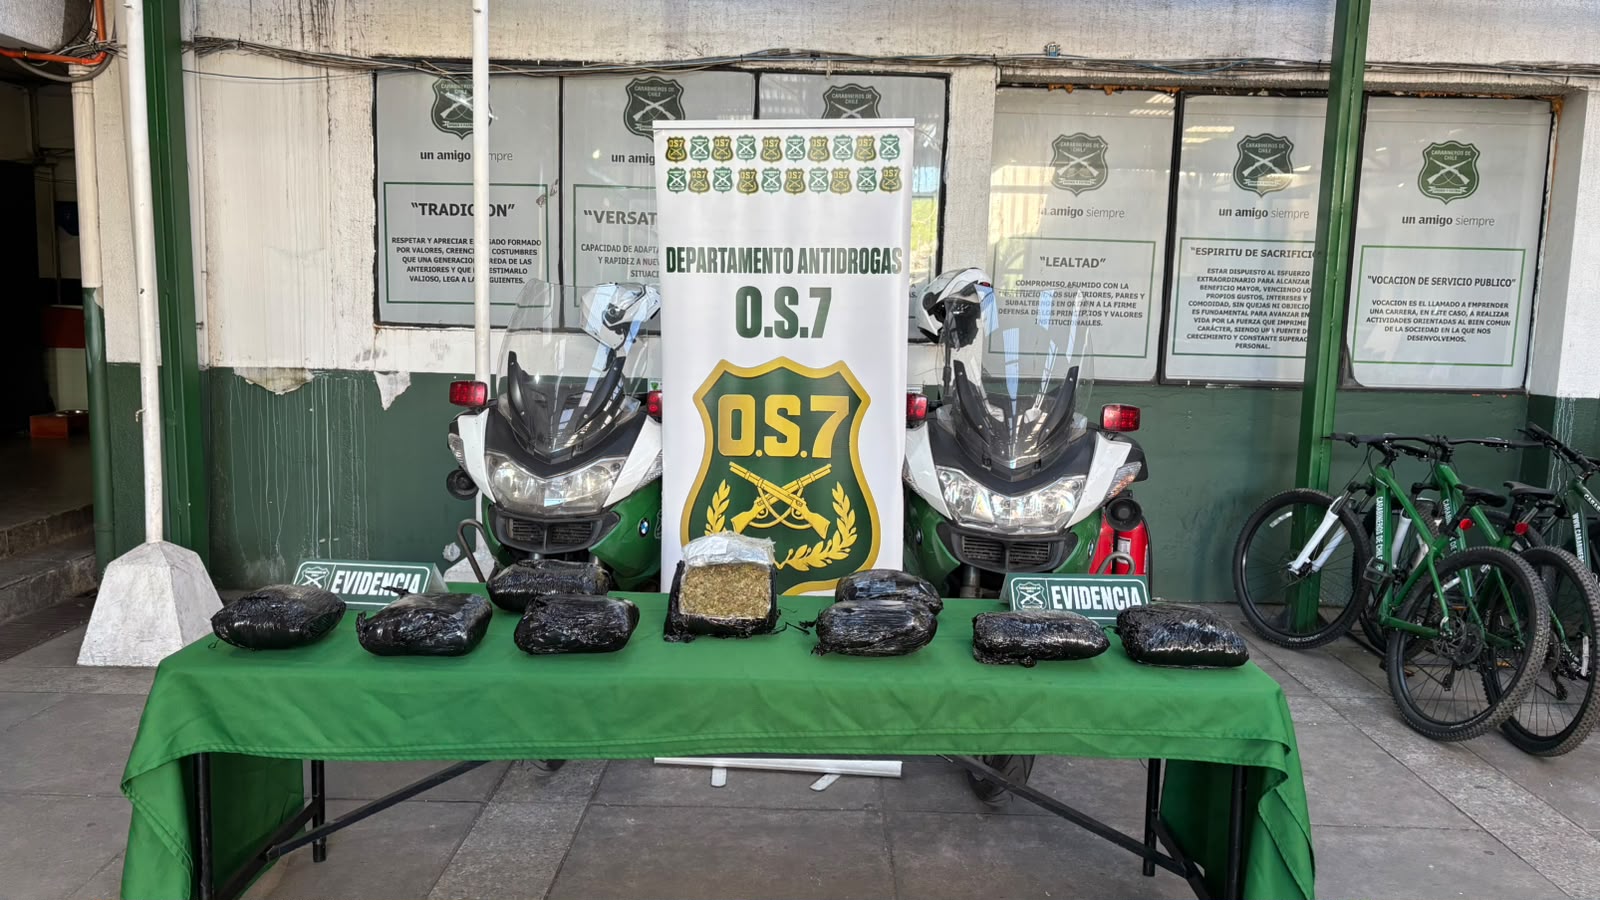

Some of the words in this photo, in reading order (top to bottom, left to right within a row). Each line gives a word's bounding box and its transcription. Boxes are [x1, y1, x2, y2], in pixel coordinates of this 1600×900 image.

[421, 152, 433, 160] un
[437, 150, 471, 162] amigo
[611, 154, 625, 162] un
[629, 153, 655, 165] amig
[411, 202, 515, 217] “TRADICON”
[1050, 207, 1084, 219] amigo
[1086, 208, 1125, 219] siempre
[1219, 208, 1232, 216] un
[1235, 207, 1268, 219] amigo
[1271, 208, 1309, 220] siempre
[584, 210, 657, 225] “VERSAT
[1402, 216, 1415, 224] un
[1418, 215, 1453, 227] amigo
[1456, 215, 1495, 228] siempre
[581, 244, 621, 252] CAPACIDAD
[1245, 249, 1258, 257] DE
[605, 257, 635, 265] RAPIDEZ
[666, 247, 794, 274] DEPARTAMENTO
[797, 247, 902, 274] ANTIDROGAS
[1418, 277, 1429, 285] DE
[1431, 277, 1472, 286] SERVICIO
[735, 286, 832, 339] O.S.7
[718, 394, 849, 458] O.S.7
[1376, 536, 1383, 544] DE
[331, 570, 421, 596] EVIDENCIA
[1051, 585, 1142, 610] EVIDENCIA
